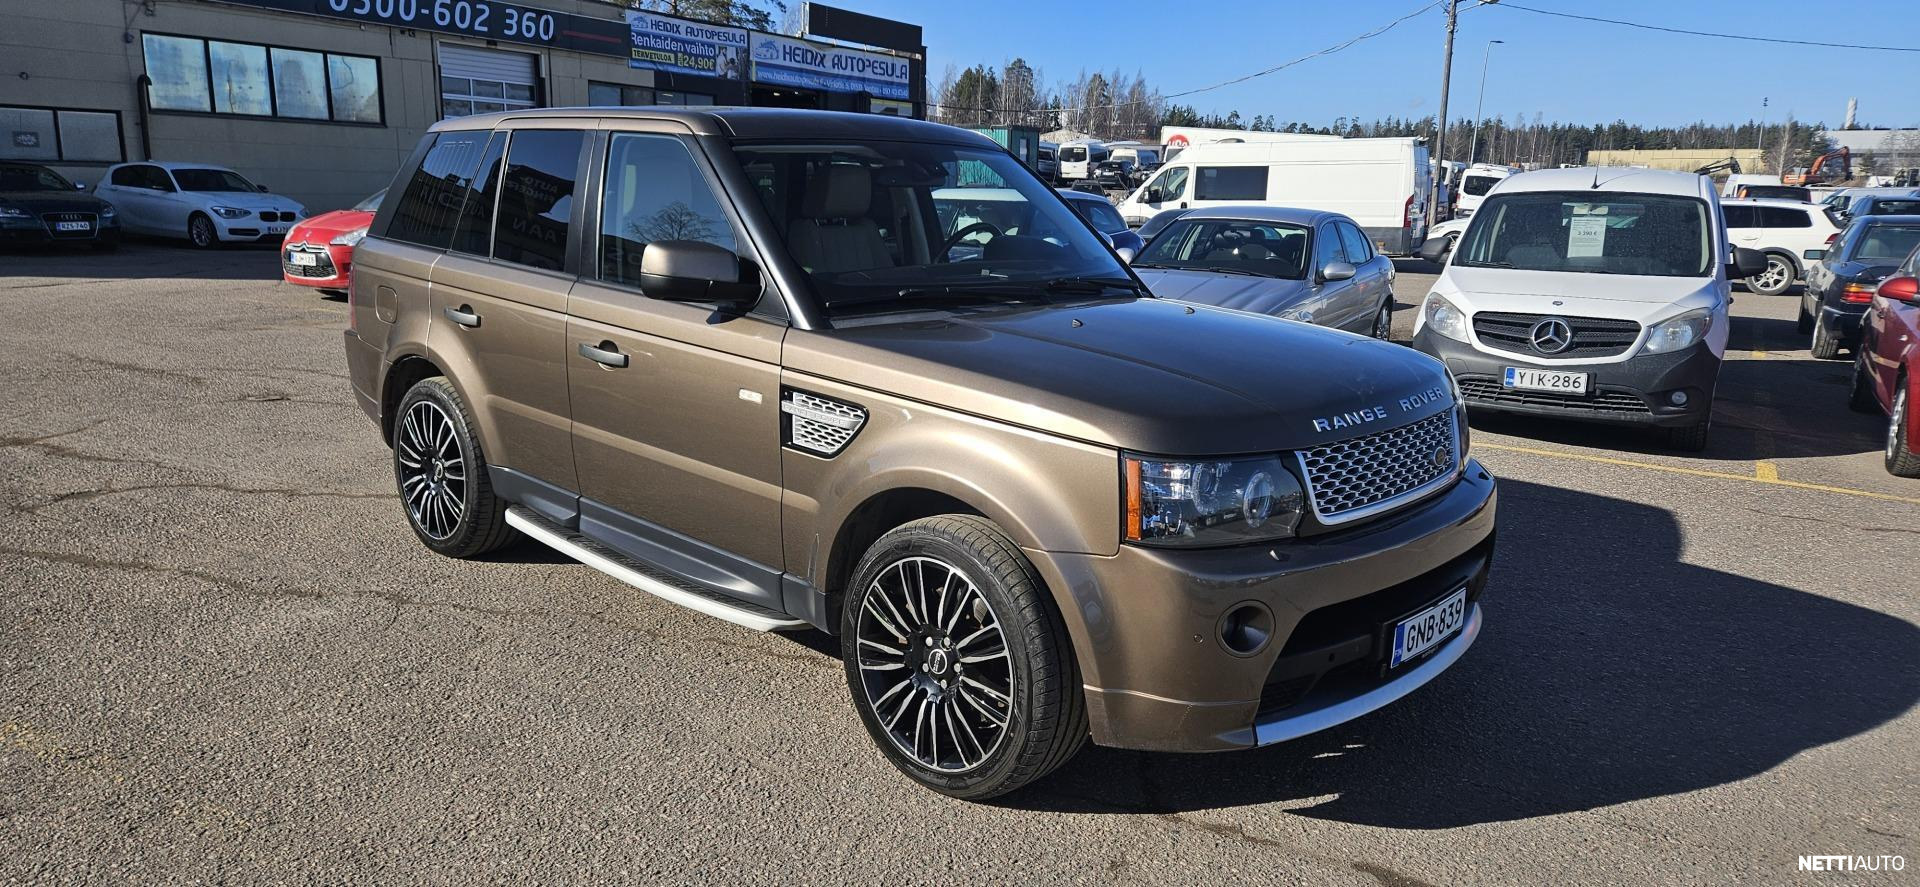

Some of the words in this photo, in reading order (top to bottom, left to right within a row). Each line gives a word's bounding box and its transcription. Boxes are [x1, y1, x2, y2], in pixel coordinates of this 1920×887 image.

[504, 8, 555, 41] 360
[650, 19, 682, 36] HEIDIX
[685, 26, 746, 45] AUTOPESULA
[631, 32, 684, 53] Renkaiden
[685, 42, 715, 57] vaihto
[782, 44, 827, 69] HEIDIX
[1518, 371, 1582, 389] YIK-286
[1312, 405, 1388, 433] RANGE
[1399, 386, 1445, 412] ROVER
[1406, 597, 1464, 653] GNB-839
